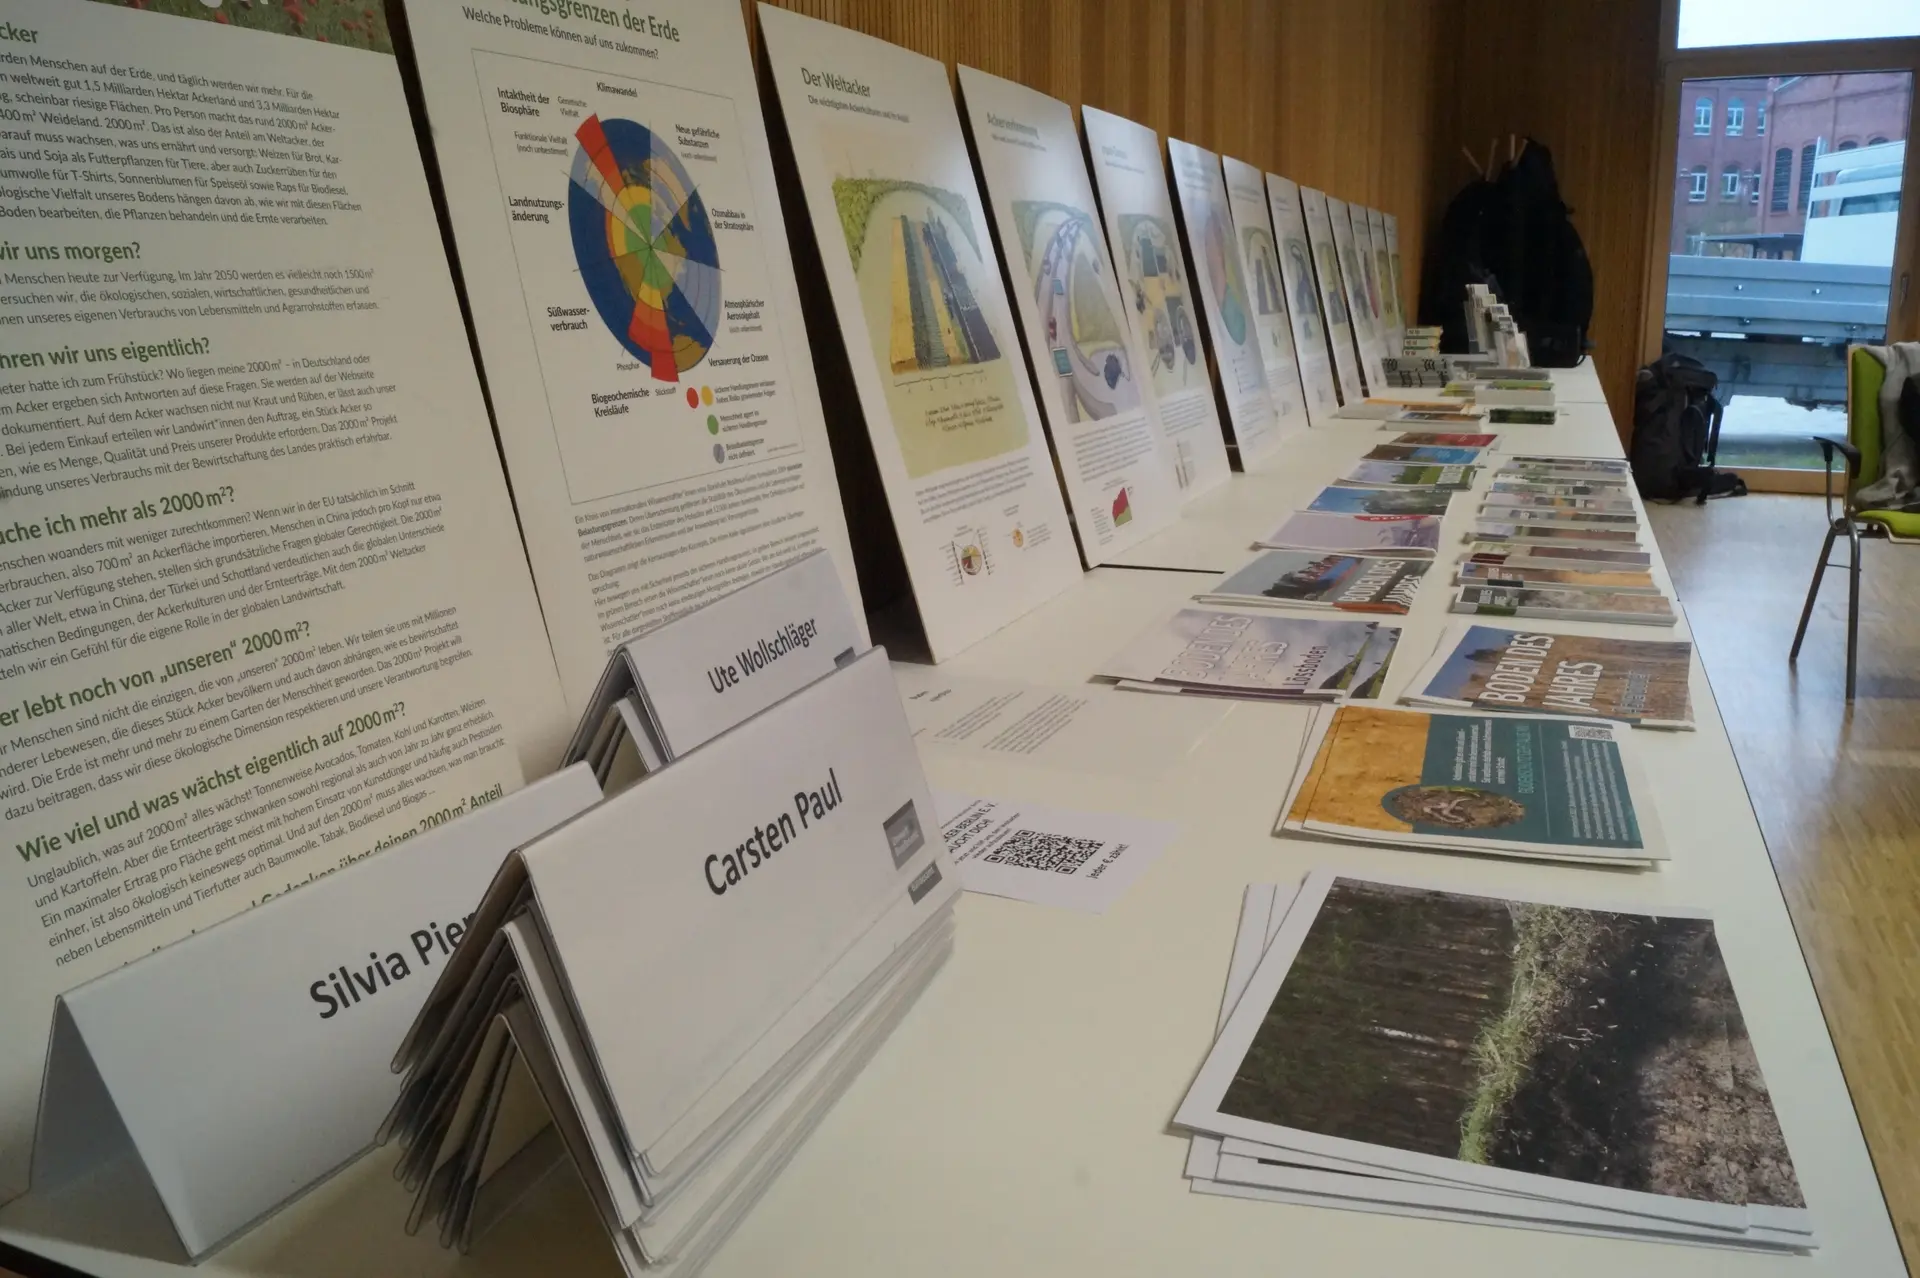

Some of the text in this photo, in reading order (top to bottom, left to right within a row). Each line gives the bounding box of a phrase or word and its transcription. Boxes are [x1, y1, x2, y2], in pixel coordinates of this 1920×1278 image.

[462, 5, 658, 59] Welche Probleme können auf uns zukommen?
[622, 10, 645, 33] der
[647, 15, 680, 42] Erde
[9, 73, 61, 87] weltweit
[62, 79, 82, 90] gut
[83, 79, 100, 92] 1,5
[102, 81, 155, 97] Milliarden
[156, 87, 188, 100] Hektar
[191, 91, 236, 106] Ackerland
[237, 99, 255, 108] und
[255, 99, 270, 110] 3,3
[496, 86, 549, 104] Intaktheit der
[596, 81, 637, 97] Klimawandel
[800, 67, 871, 97] Der Weltacker
[500, 101, 539, 116] Biosphäre
[507, 195, 564, 210] Landnutzungs-
[511, 209, 549, 224] änderung
[24, 245, 60, 260] uns
[63, 240, 140, 263] morgen?
[4, 271, 65, 284] Menschen
[67, 271, 99, 283] heute
[103, 273, 118, 282] zur
[119, 270, 176, 284] Verfügung.
[177, 270, 191, 280] Im
[193, 269, 212, 280] Jahr
[214, 269, 239, 280] 2050
[239, 269, 273, 280] werden
[274, 271, 284, 279] es
[546, 306, 589, 317] Süßwasser-
[550, 318, 588, 331] verbrauch
[47, 345, 79, 365] wir
[83, 347, 117, 362] uns
[120, 336, 209, 362] eigentlich?
[591, 387, 649, 404] Biogeochemische
[593, 403, 629, 417] Kreisläufe
[45, 513, 76, 536] ich
[79, 505, 127, 530] mehr
[132, 499, 157, 520] als
[5, 620, 30, 634] aller
[33, 611, 66, 626] Welt,
[68, 604, 97, 619] etwa
[99, 600, 110, 611] in
[113, 593, 147, 608] China,
[148, 587, 165, 600] der
[168, 578, 199, 594] Türkei
[200, 572, 220, 587] und
[221, 561, 271, 582] Schottland
[272, 550, 330, 570] verdeutlichen
[331, 543, 351, 556] auch
[352, 540, 364, 551] die
[365, 534, 396, 551] globalen
[707, 618, 819, 694] Ute Wollschläger
[1505, 633, 1555, 657] DES
[1282, 645, 1329, 686] Lössboden
[1478, 656, 1544, 703] BODEN
[23, 692, 65, 719] lebt
[68, 677, 116, 706] noch
[118, 670, 154, 690] von
[1542, 660, 1604, 712] JAHRES
[16, 834, 61, 862] Wie
[63, 815, 100, 844] viel
[103, 799, 140, 829] und
[142, 790, 179, 814] was
[181, 764, 242, 799] wächst
[245, 735, 319, 775] eigentlich
[321, 723, 344, 746] auf
[28, 851, 100, 887] Unglaublich,
[102, 842, 125, 857] was
[127, 831, 144, 848] auf
[191, 806, 214, 822] alles
[216, 788, 252, 812] wächst!
[253, 767, 312, 796] Tonnenweise
[314, 750, 355, 773] Avocados,
[357, 735, 393, 755] Tomaten,
[394, 725, 411, 740] Kohl
[412, 719, 427, 733] und
[427, 709, 460, 726] Karotten,
[470, 782, 503, 810] Anteil
[704, 767, 843, 896] Carsten Paul
[55, 789, 427, 967] neben Lebensmitteln und Tierfutter auch Baumwolle, Tabak, Biodiesel und Biogas
[310, 952, 411, 1019] Silvia
